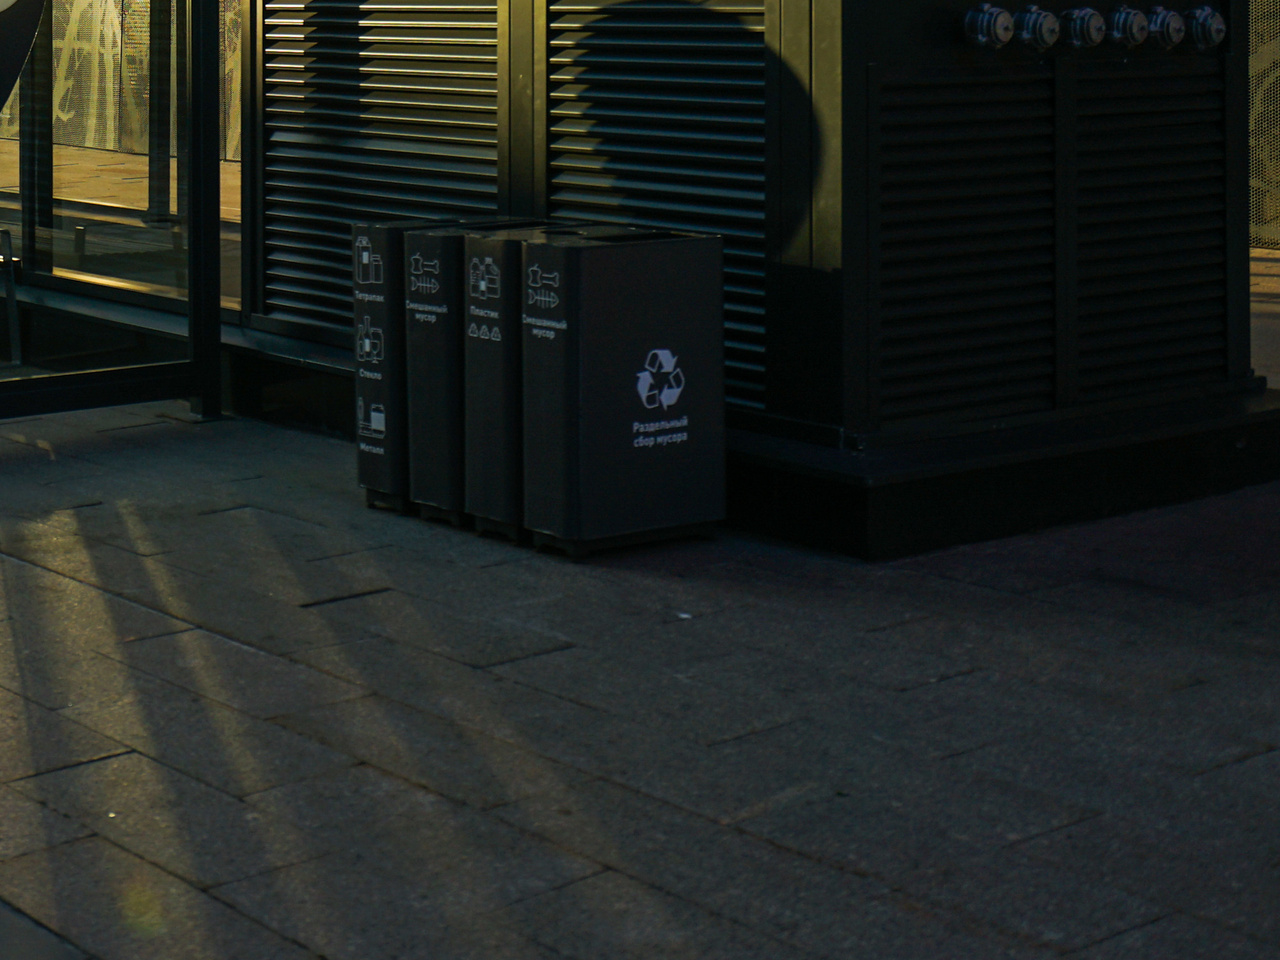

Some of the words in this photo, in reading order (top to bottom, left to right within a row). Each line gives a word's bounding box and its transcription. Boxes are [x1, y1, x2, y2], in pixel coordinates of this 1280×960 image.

[633, 415, 688, 433] Раздельный
[633, 435, 656, 448] сбор
[656, 432, 688, 446] мусора
